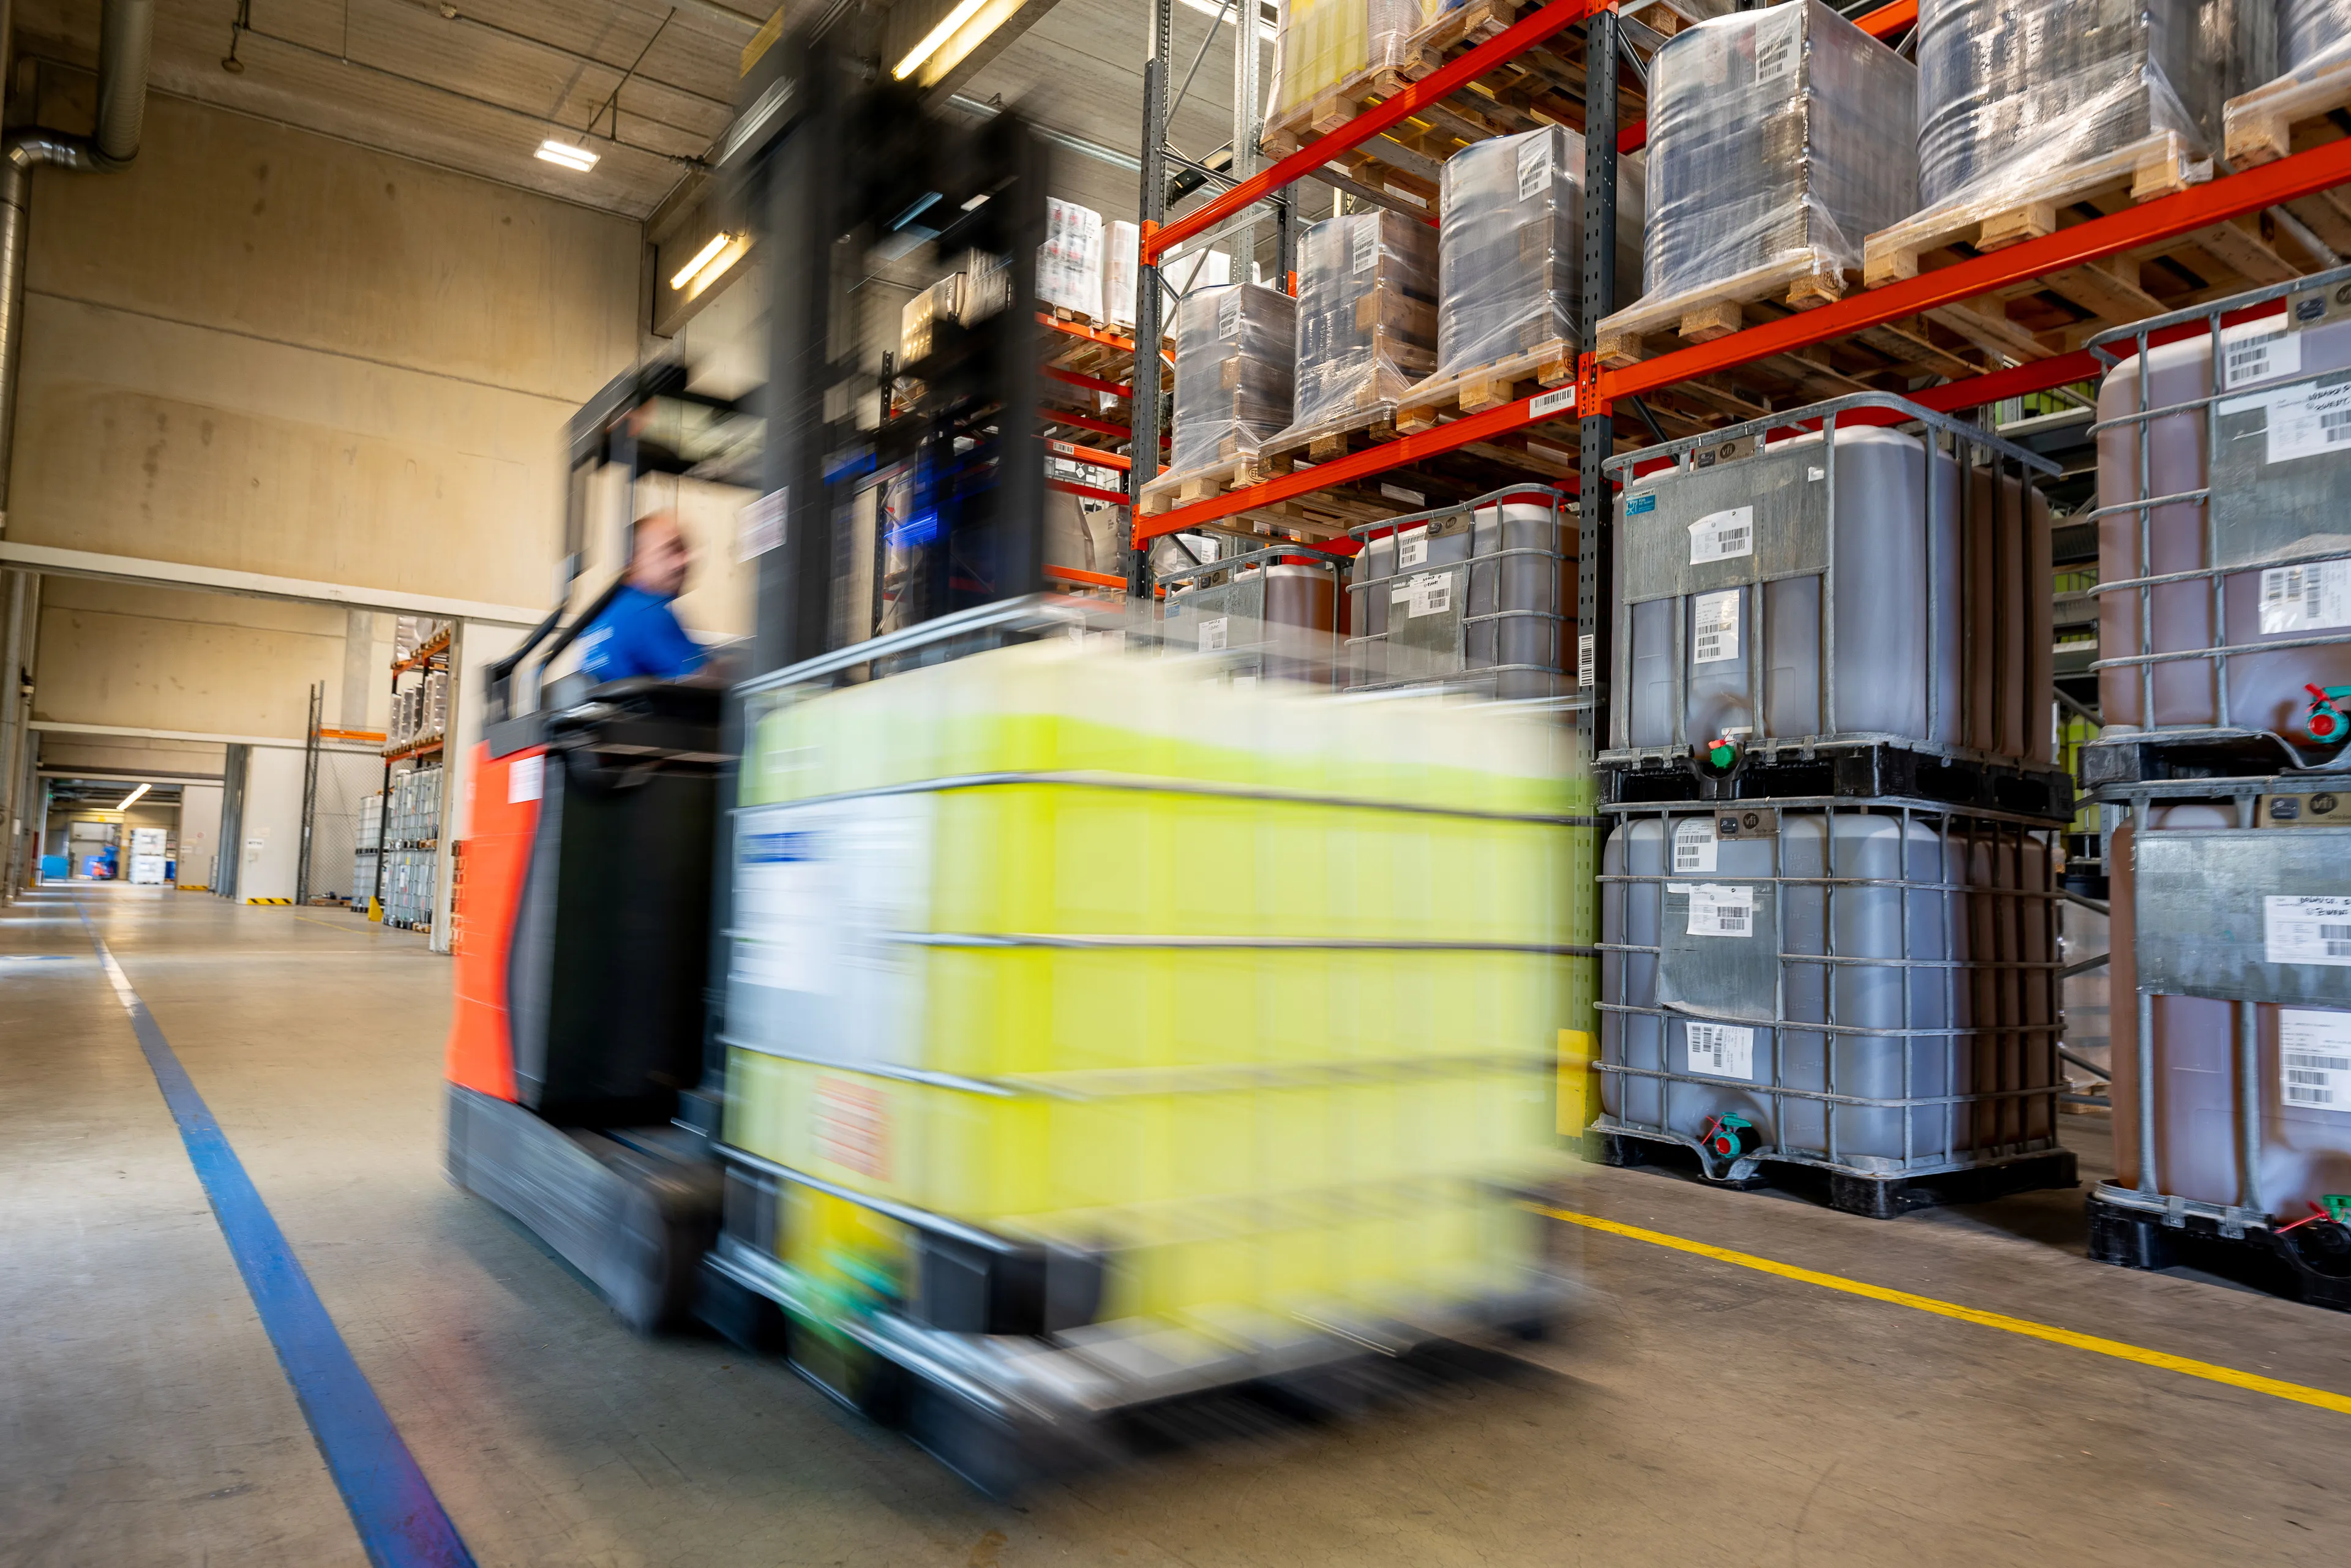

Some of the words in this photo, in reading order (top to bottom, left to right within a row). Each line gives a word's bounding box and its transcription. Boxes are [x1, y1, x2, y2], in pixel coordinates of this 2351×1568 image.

[1722, 445, 1733, 456] vfi
[2312, 797, 2333, 809] vfi
[1744, 815, 1757, 826] vfi
